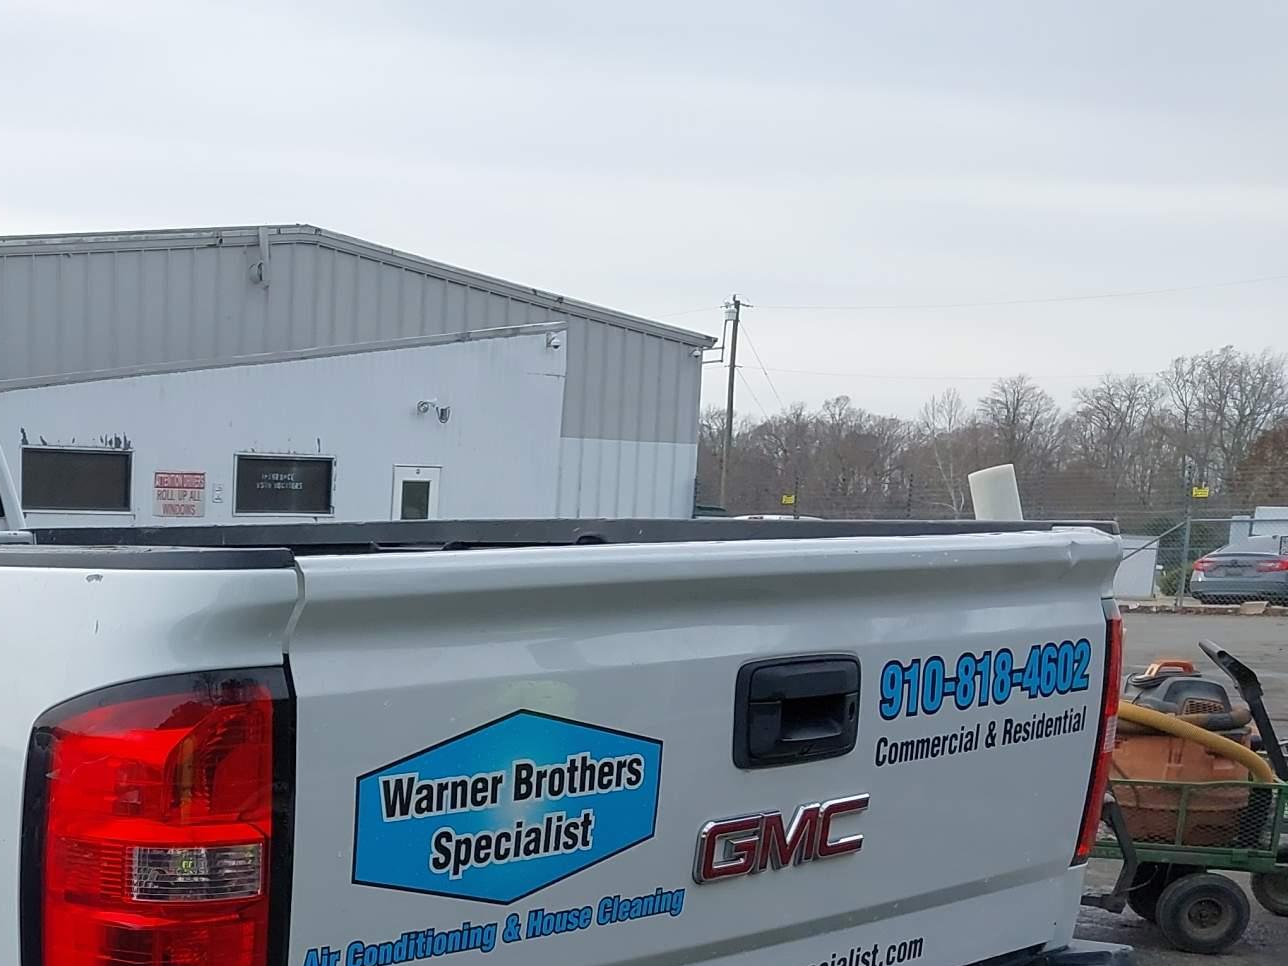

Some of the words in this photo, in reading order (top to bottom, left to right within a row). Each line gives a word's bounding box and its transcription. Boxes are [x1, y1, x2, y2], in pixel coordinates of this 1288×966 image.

[157, 490, 176, 501] ROLL
[178, 490, 187, 501] UP
[189, 490, 201, 501] ALL
[162, 503, 196, 516] WINDOWS
[878, 638, 1092, 721] 910-818-4602
[874, 726, 982, 769] Commercial
[985, 723, 998, 749] &
[1001, 707, 1087, 747] Residential
[379, 768, 503, 820] Warner
[512, 752, 644, 802] Brothers
[429, 811, 595, 876] Specialist
[692, 792, 870, 885] GMC
[502, 914, 521, 943] &
[526, 903, 594, 941] House
[596, 886, 685, 925] Cleaning
